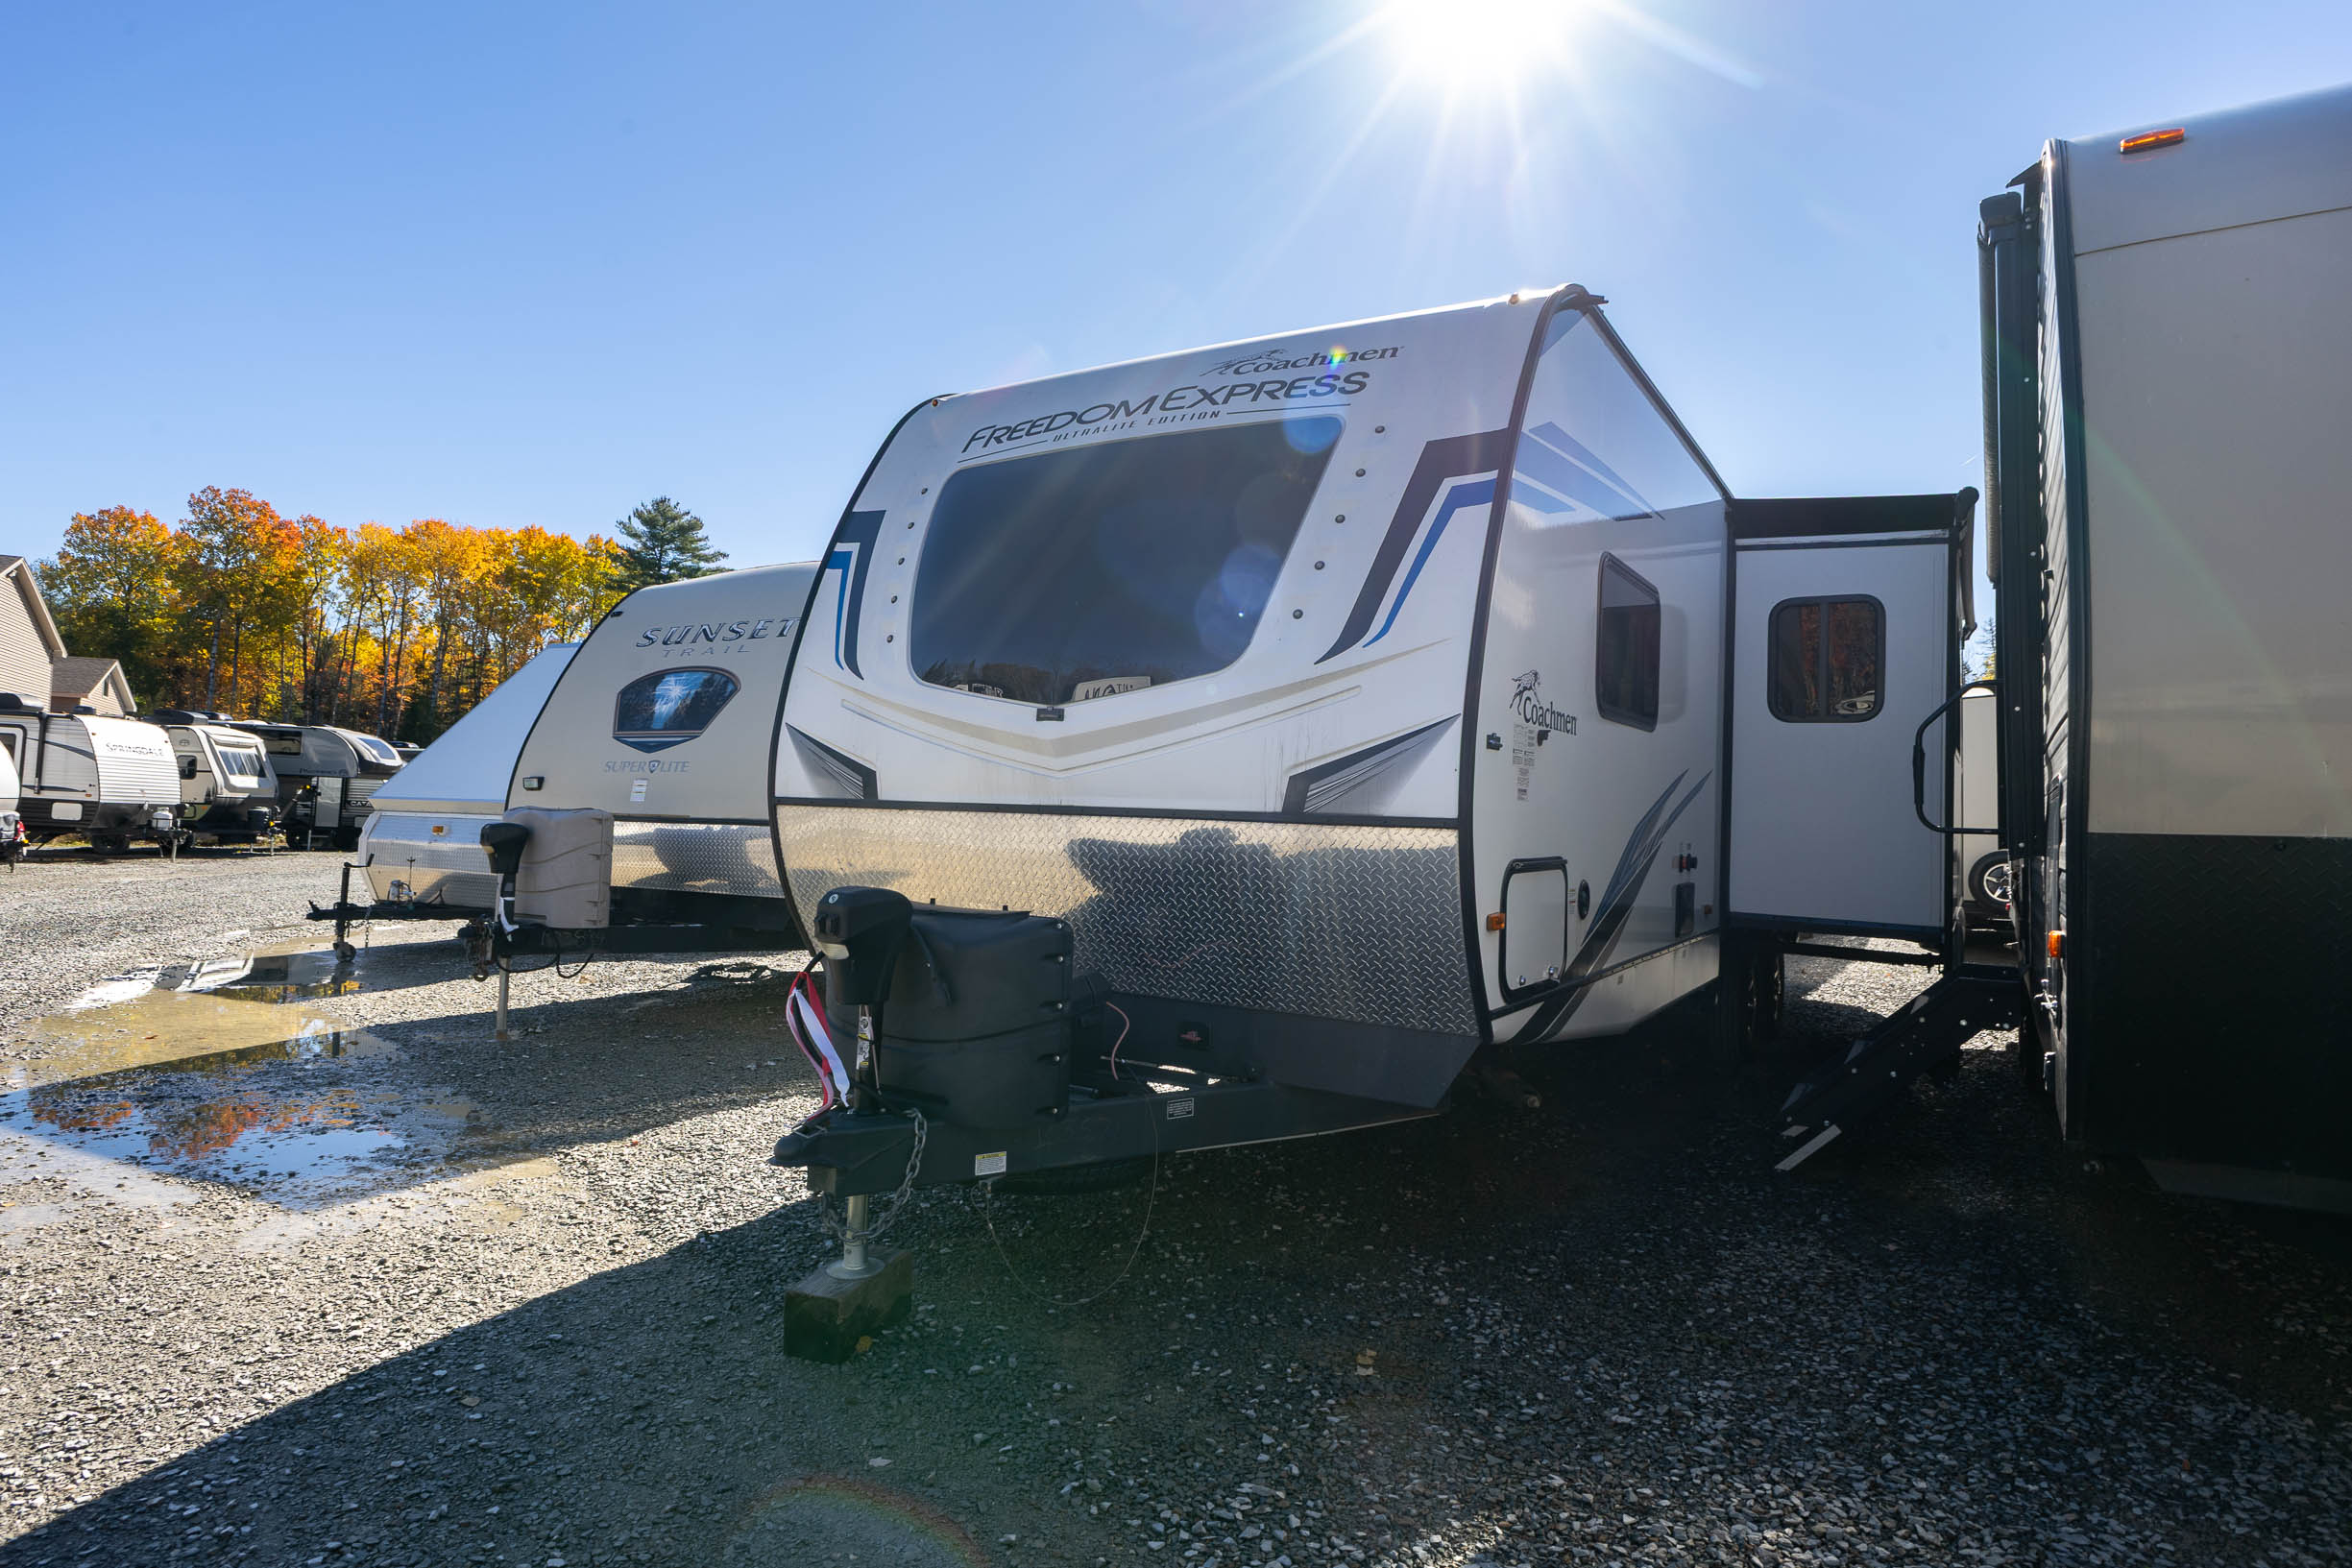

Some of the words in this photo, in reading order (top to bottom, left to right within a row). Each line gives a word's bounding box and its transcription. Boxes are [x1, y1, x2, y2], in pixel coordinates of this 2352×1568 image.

[1232, 347, 1400, 375] Coachmen
[961, 395, 1159, 453] FREEDOM
[1159, 372, 1370, 412] EXPRESS
[1053, 421, 1137, 443] ULTRALITE
[1148, 410, 1220, 425] EDITION
[636, 616, 803, 648] SUNSET
[663, 644, 750, 658] TRAIL
[1523, 696, 1578, 736] Coachmen
[605, 760, 646, 772] SUPER
[660, 760, 690, 772] LITE
